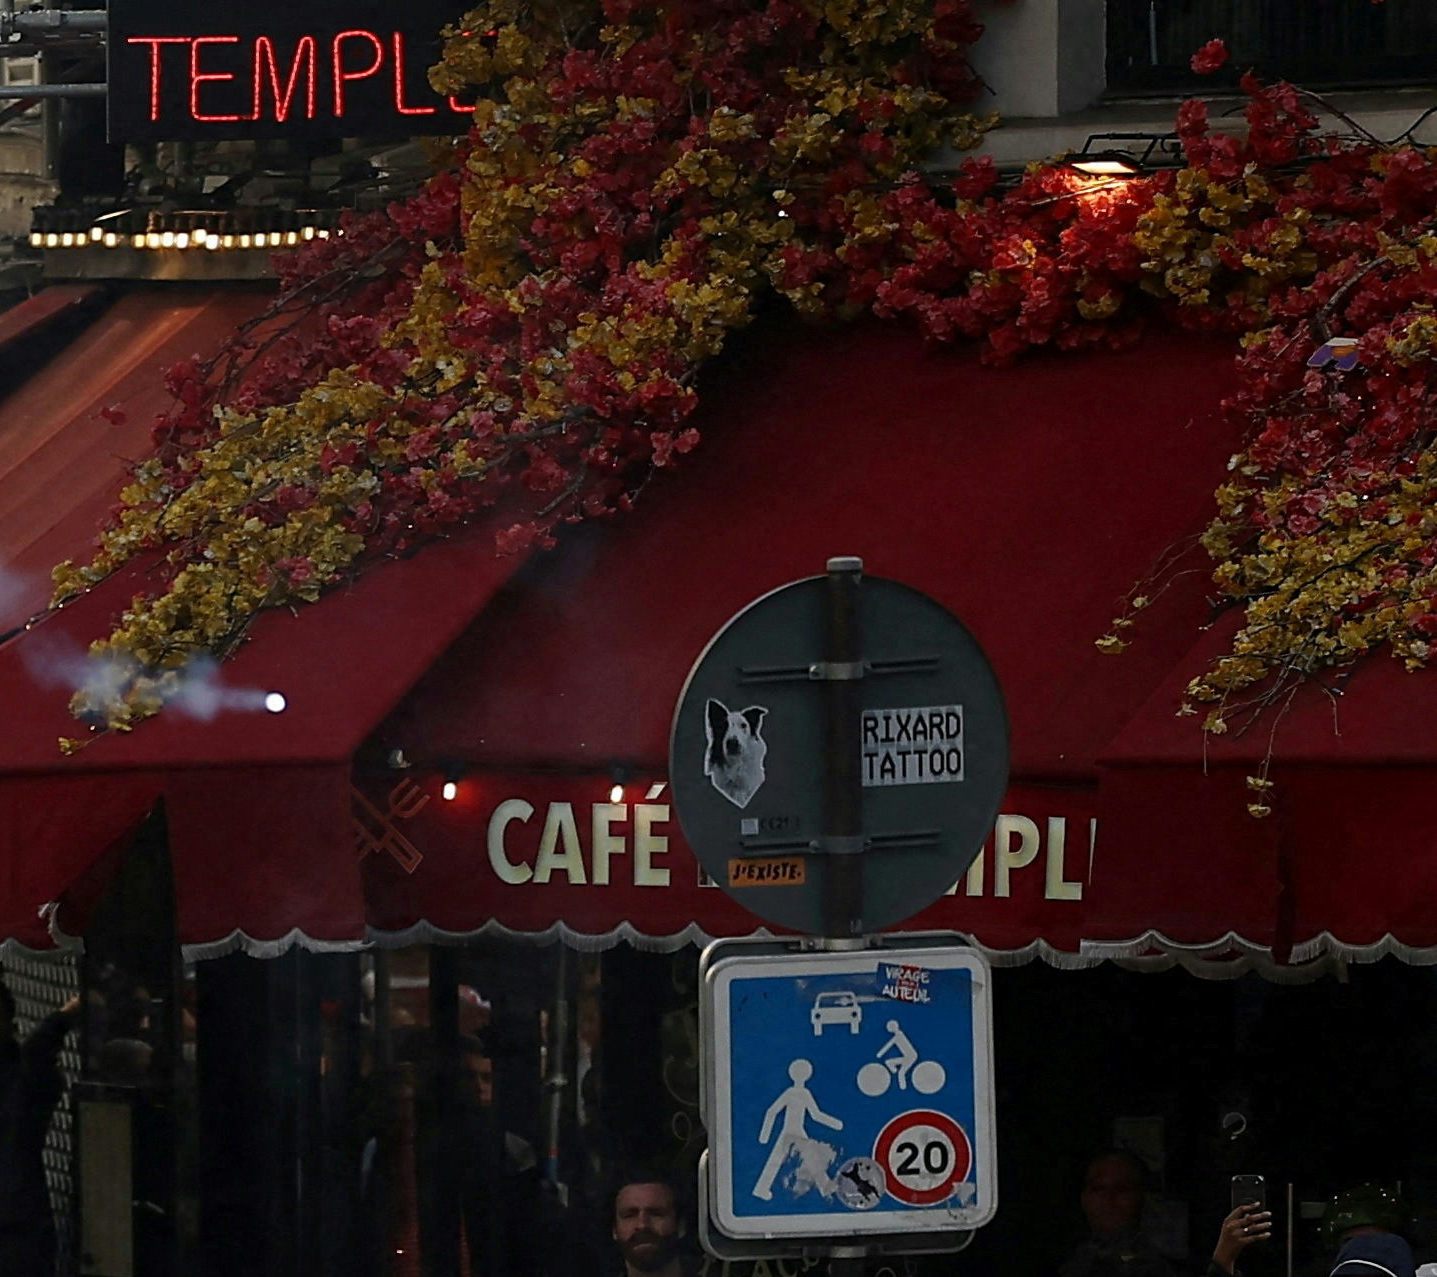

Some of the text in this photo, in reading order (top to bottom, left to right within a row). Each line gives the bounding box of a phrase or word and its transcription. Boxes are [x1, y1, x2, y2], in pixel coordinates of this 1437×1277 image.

[126, 30, 496, 122] TEMPL
[863, 711, 962, 745] RIXARD
[863, 747, 962, 780] TATTOO
[487, 781, 672, 888] CAFÉ
[895, 1140, 950, 1177] 20
